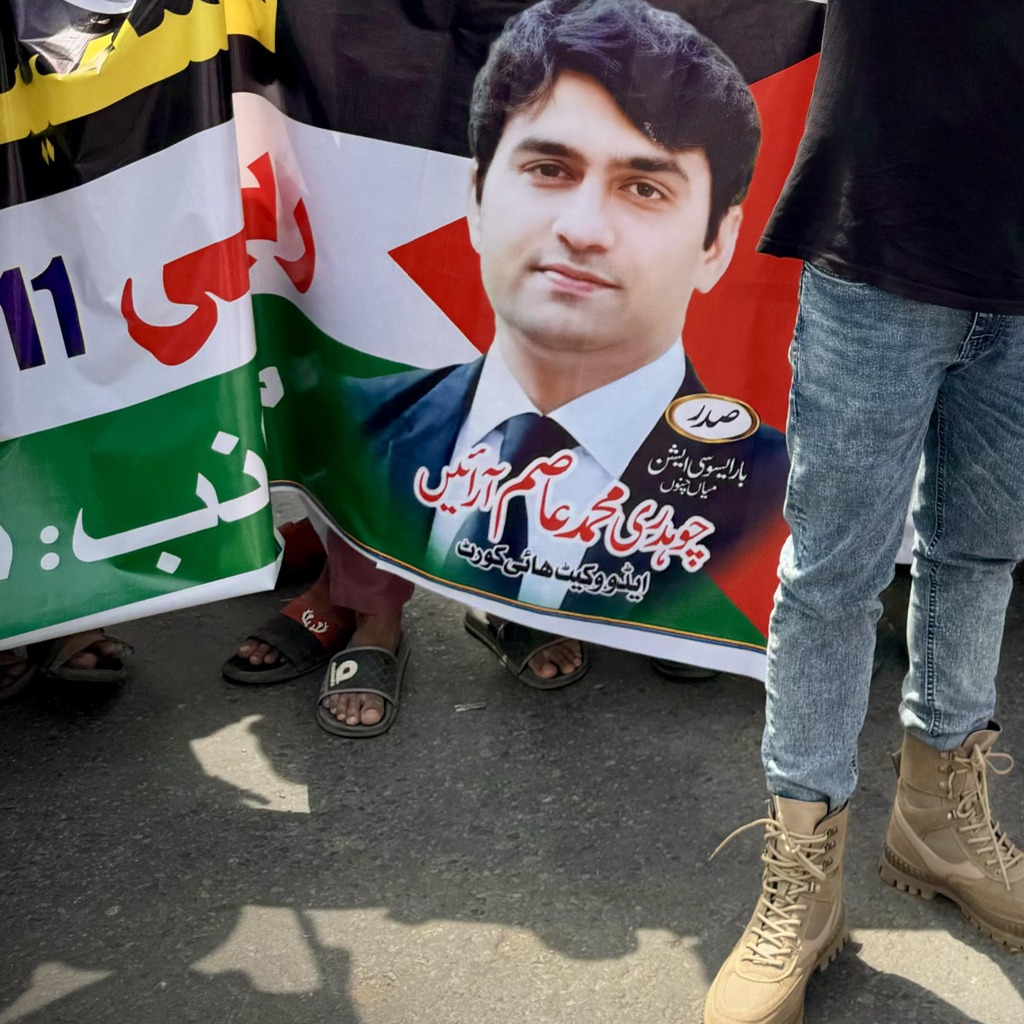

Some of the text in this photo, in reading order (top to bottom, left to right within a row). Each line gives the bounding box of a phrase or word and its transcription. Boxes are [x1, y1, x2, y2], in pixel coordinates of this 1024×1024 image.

[686, 404, 740, 429] صدر
[553, 484, 626, 543] محمد
[457, 539, 506, 570] کورٹ
